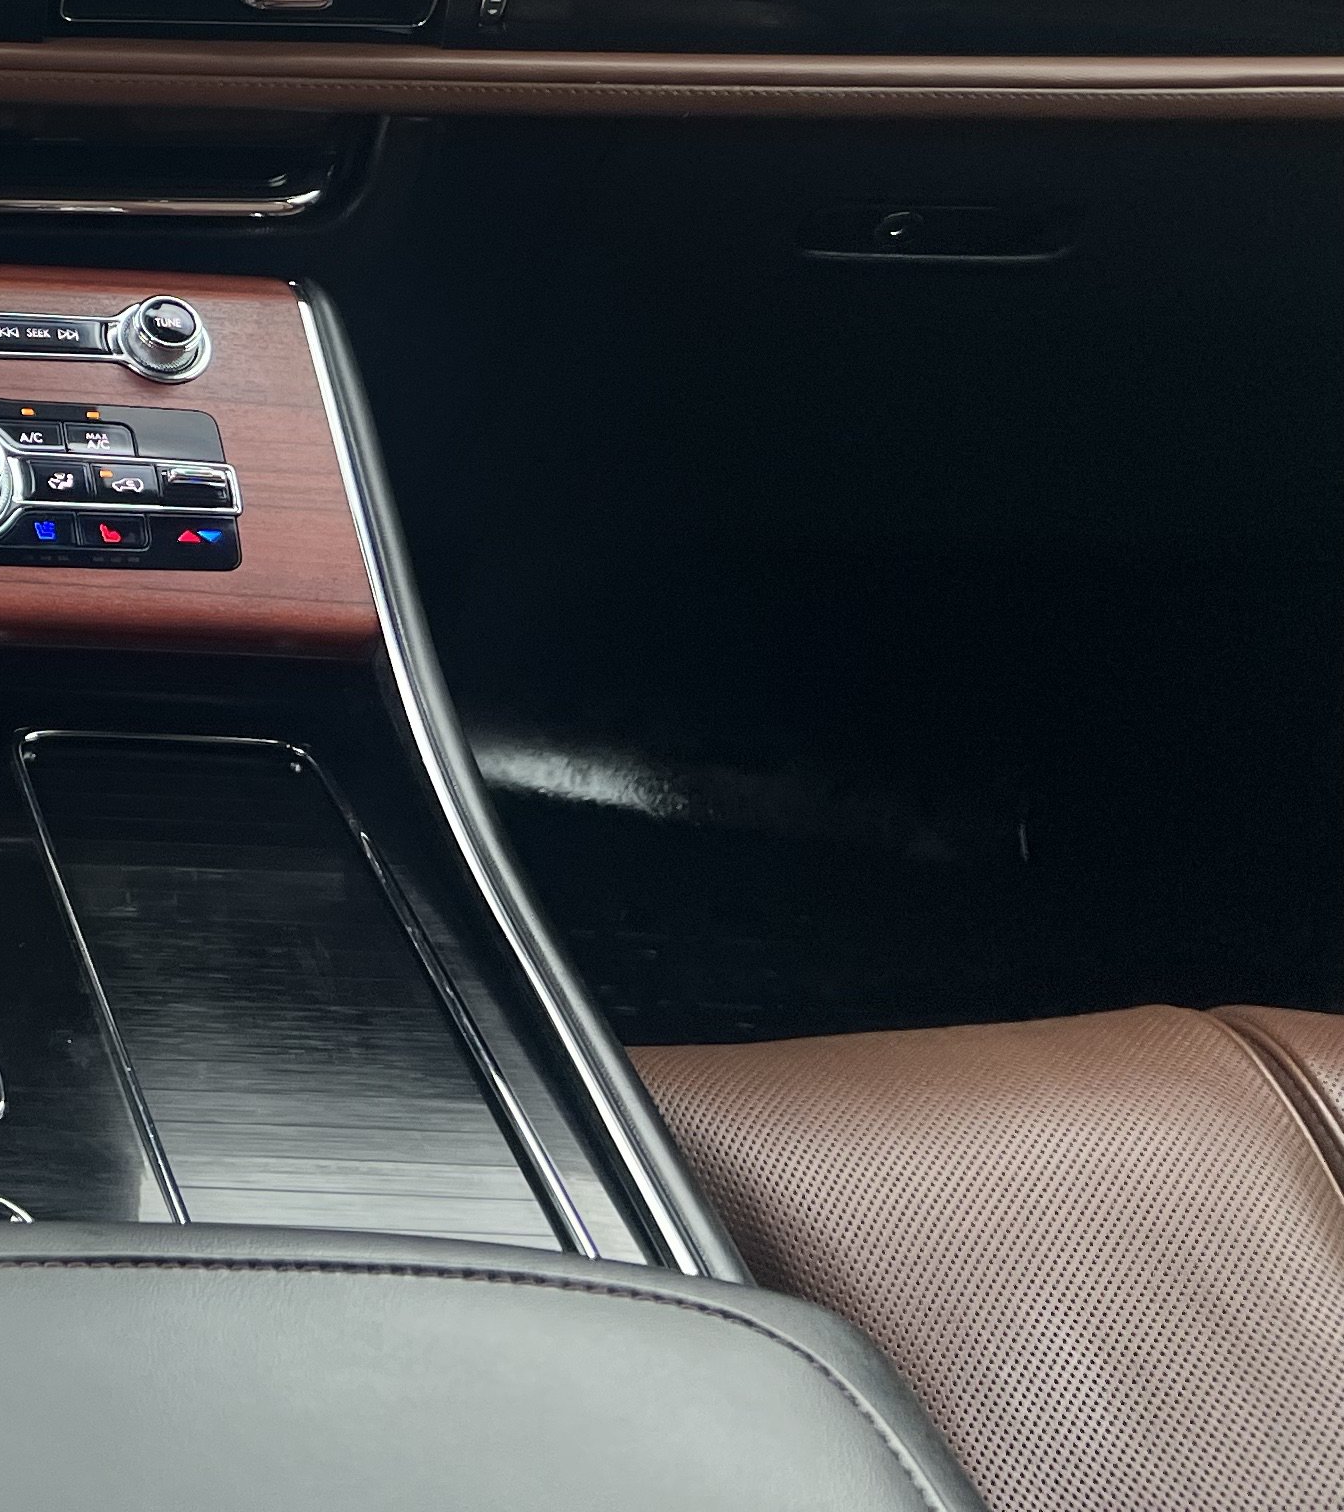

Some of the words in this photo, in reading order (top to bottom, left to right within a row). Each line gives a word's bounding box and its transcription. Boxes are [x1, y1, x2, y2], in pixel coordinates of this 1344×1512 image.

[153, 317, 182, 328] TUNE
[26, 328, 51, 339] SEEK
[19, 432, 43, 444] A/C
[85, 432, 108, 440] MAX
[87, 439, 111, 450] A/C
